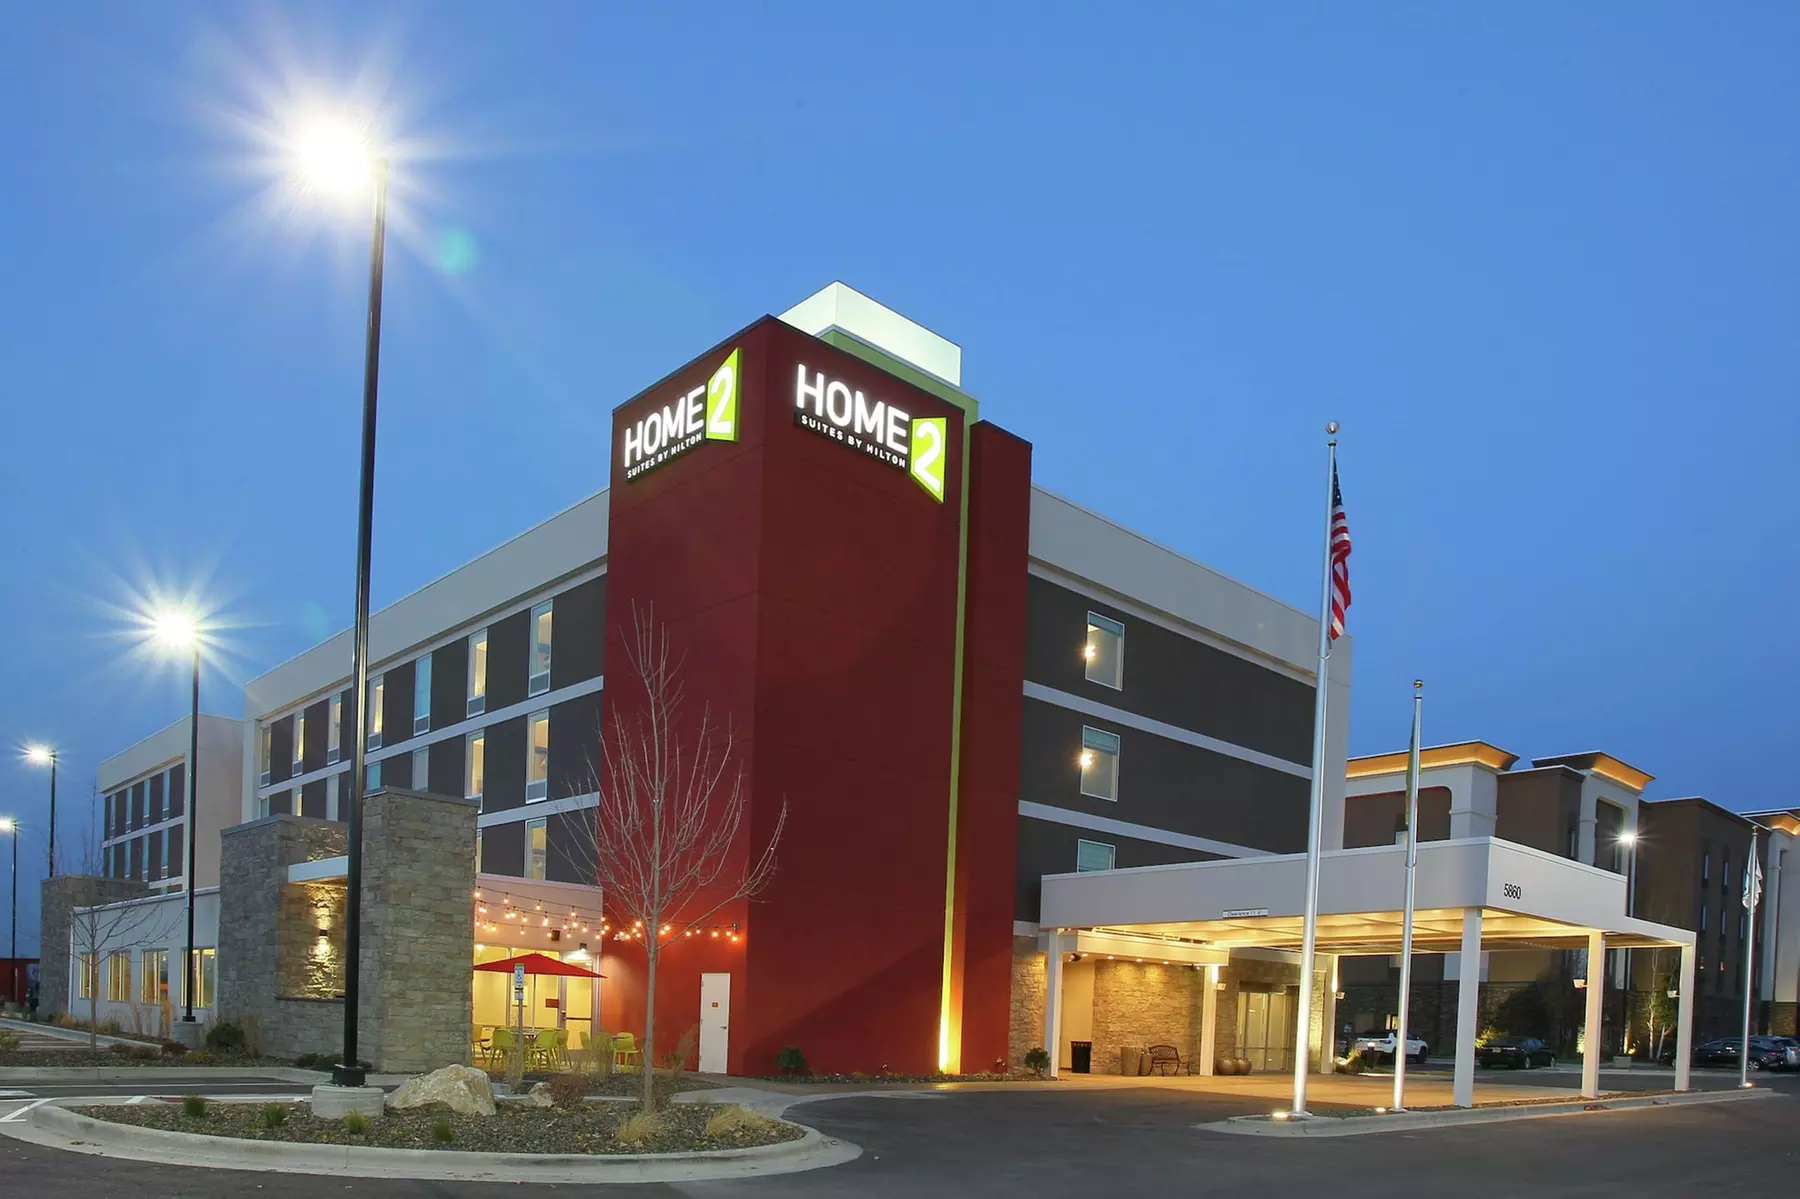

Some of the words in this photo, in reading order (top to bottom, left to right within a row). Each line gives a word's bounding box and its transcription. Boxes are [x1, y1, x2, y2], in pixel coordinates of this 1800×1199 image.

[624, 384, 706, 468] HOME
[708, 364, 734, 434] 2
[796, 363, 910, 455] HOME
[913, 421, 942, 494] 2
[801, 414, 844, 441] SUITES
[847, 434, 863, 449] BY
[866, 443, 906, 468] HILTON
[627, 457, 655, 479] SUITES
[657, 450, 669, 463] BY
[670, 432, 702, 456] HILTON
[1503, 882, 1522, 900] 5860
